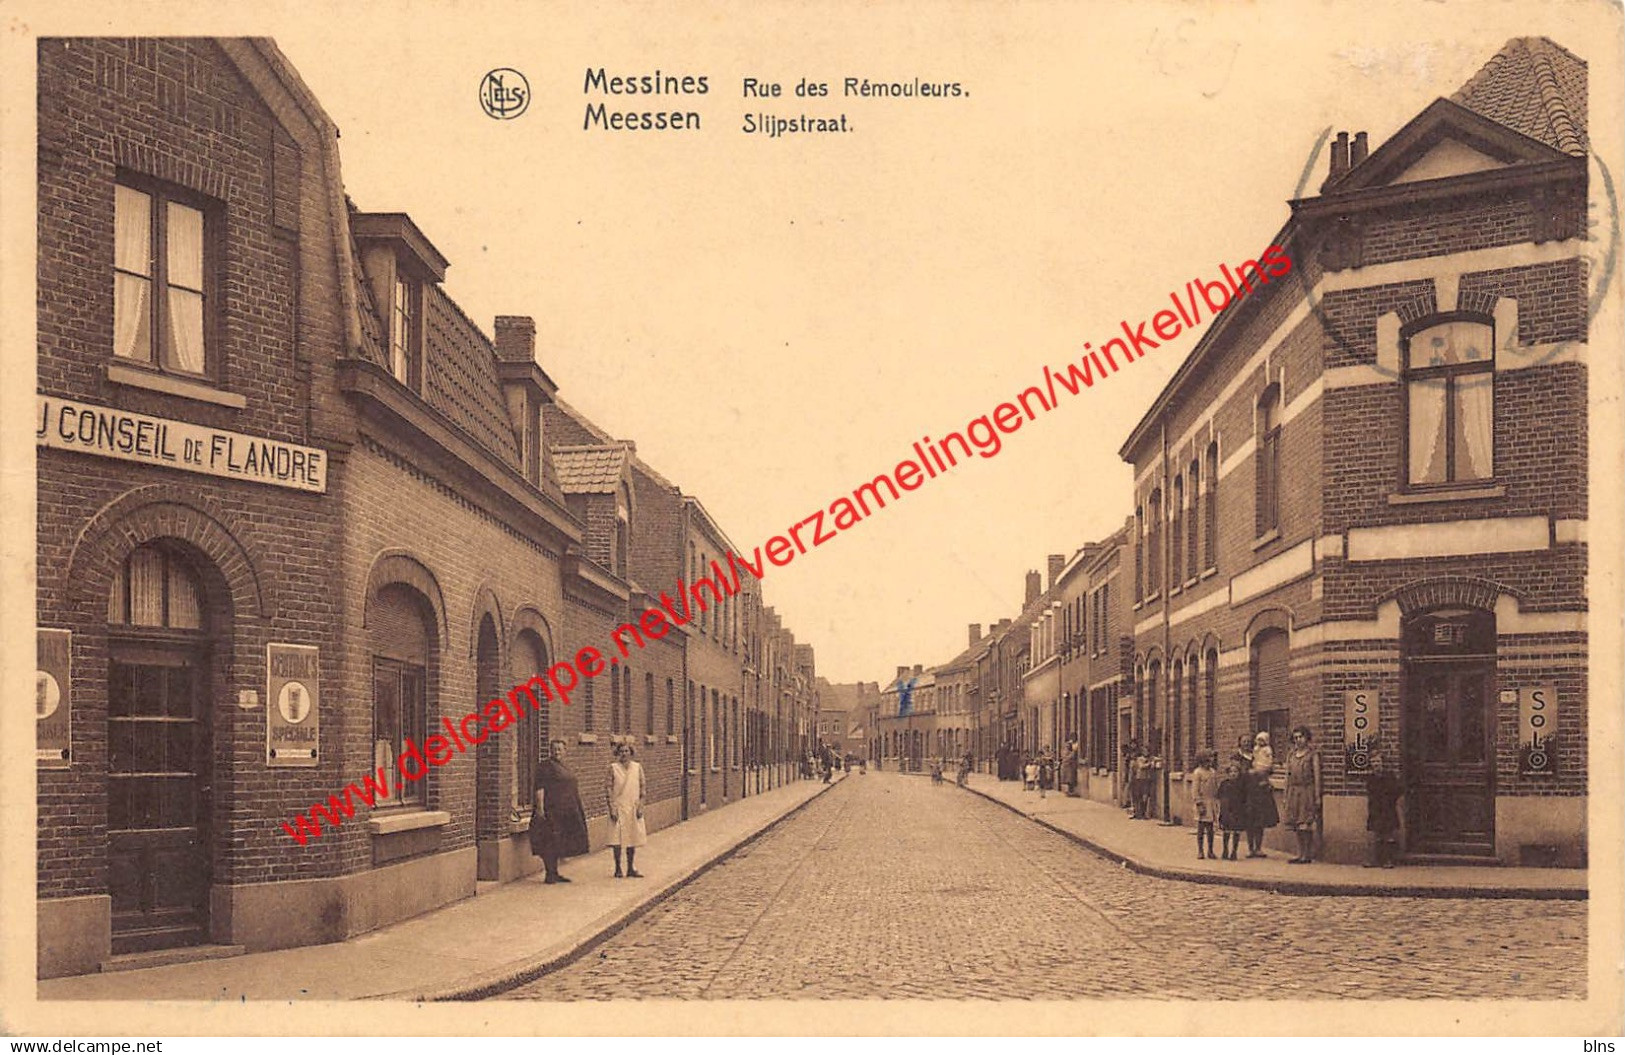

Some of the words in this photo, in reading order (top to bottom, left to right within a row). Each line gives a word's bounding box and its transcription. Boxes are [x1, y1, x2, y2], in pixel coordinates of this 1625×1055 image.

[59, 405, 177, 461] CONSEIL
[184, 437, 203, 465] DE
[210, 433, 321, 486] FLANDRE
